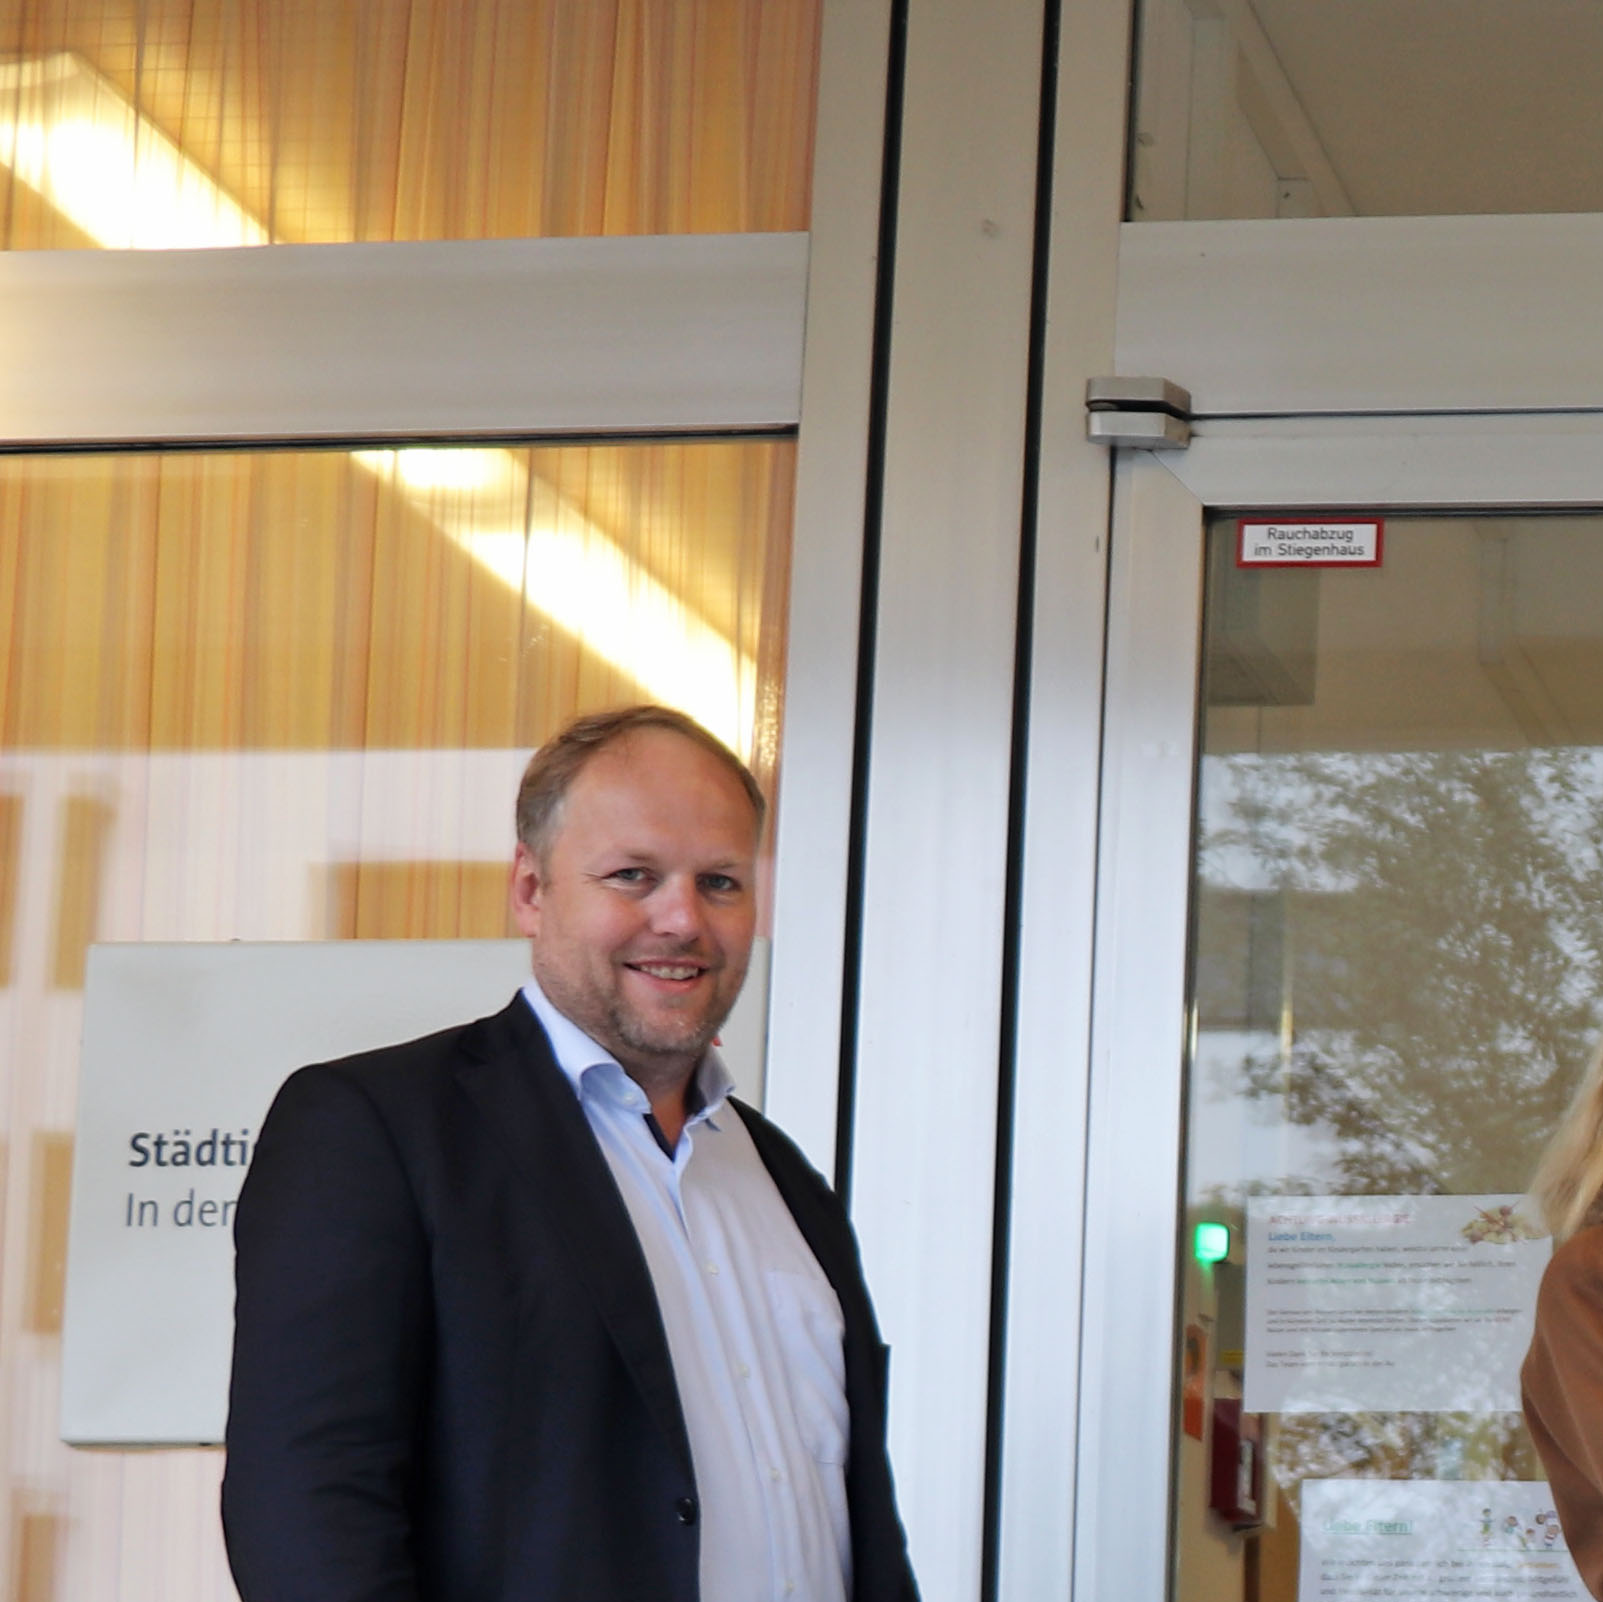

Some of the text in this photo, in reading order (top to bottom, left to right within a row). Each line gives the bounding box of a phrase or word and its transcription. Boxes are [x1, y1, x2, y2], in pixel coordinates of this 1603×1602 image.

[1267, 527, 1354, 542] Rauchabzug
[1254, 543, 1364, 558] im Stiegenhaus
[126, 1187, 238, 1227] In der
